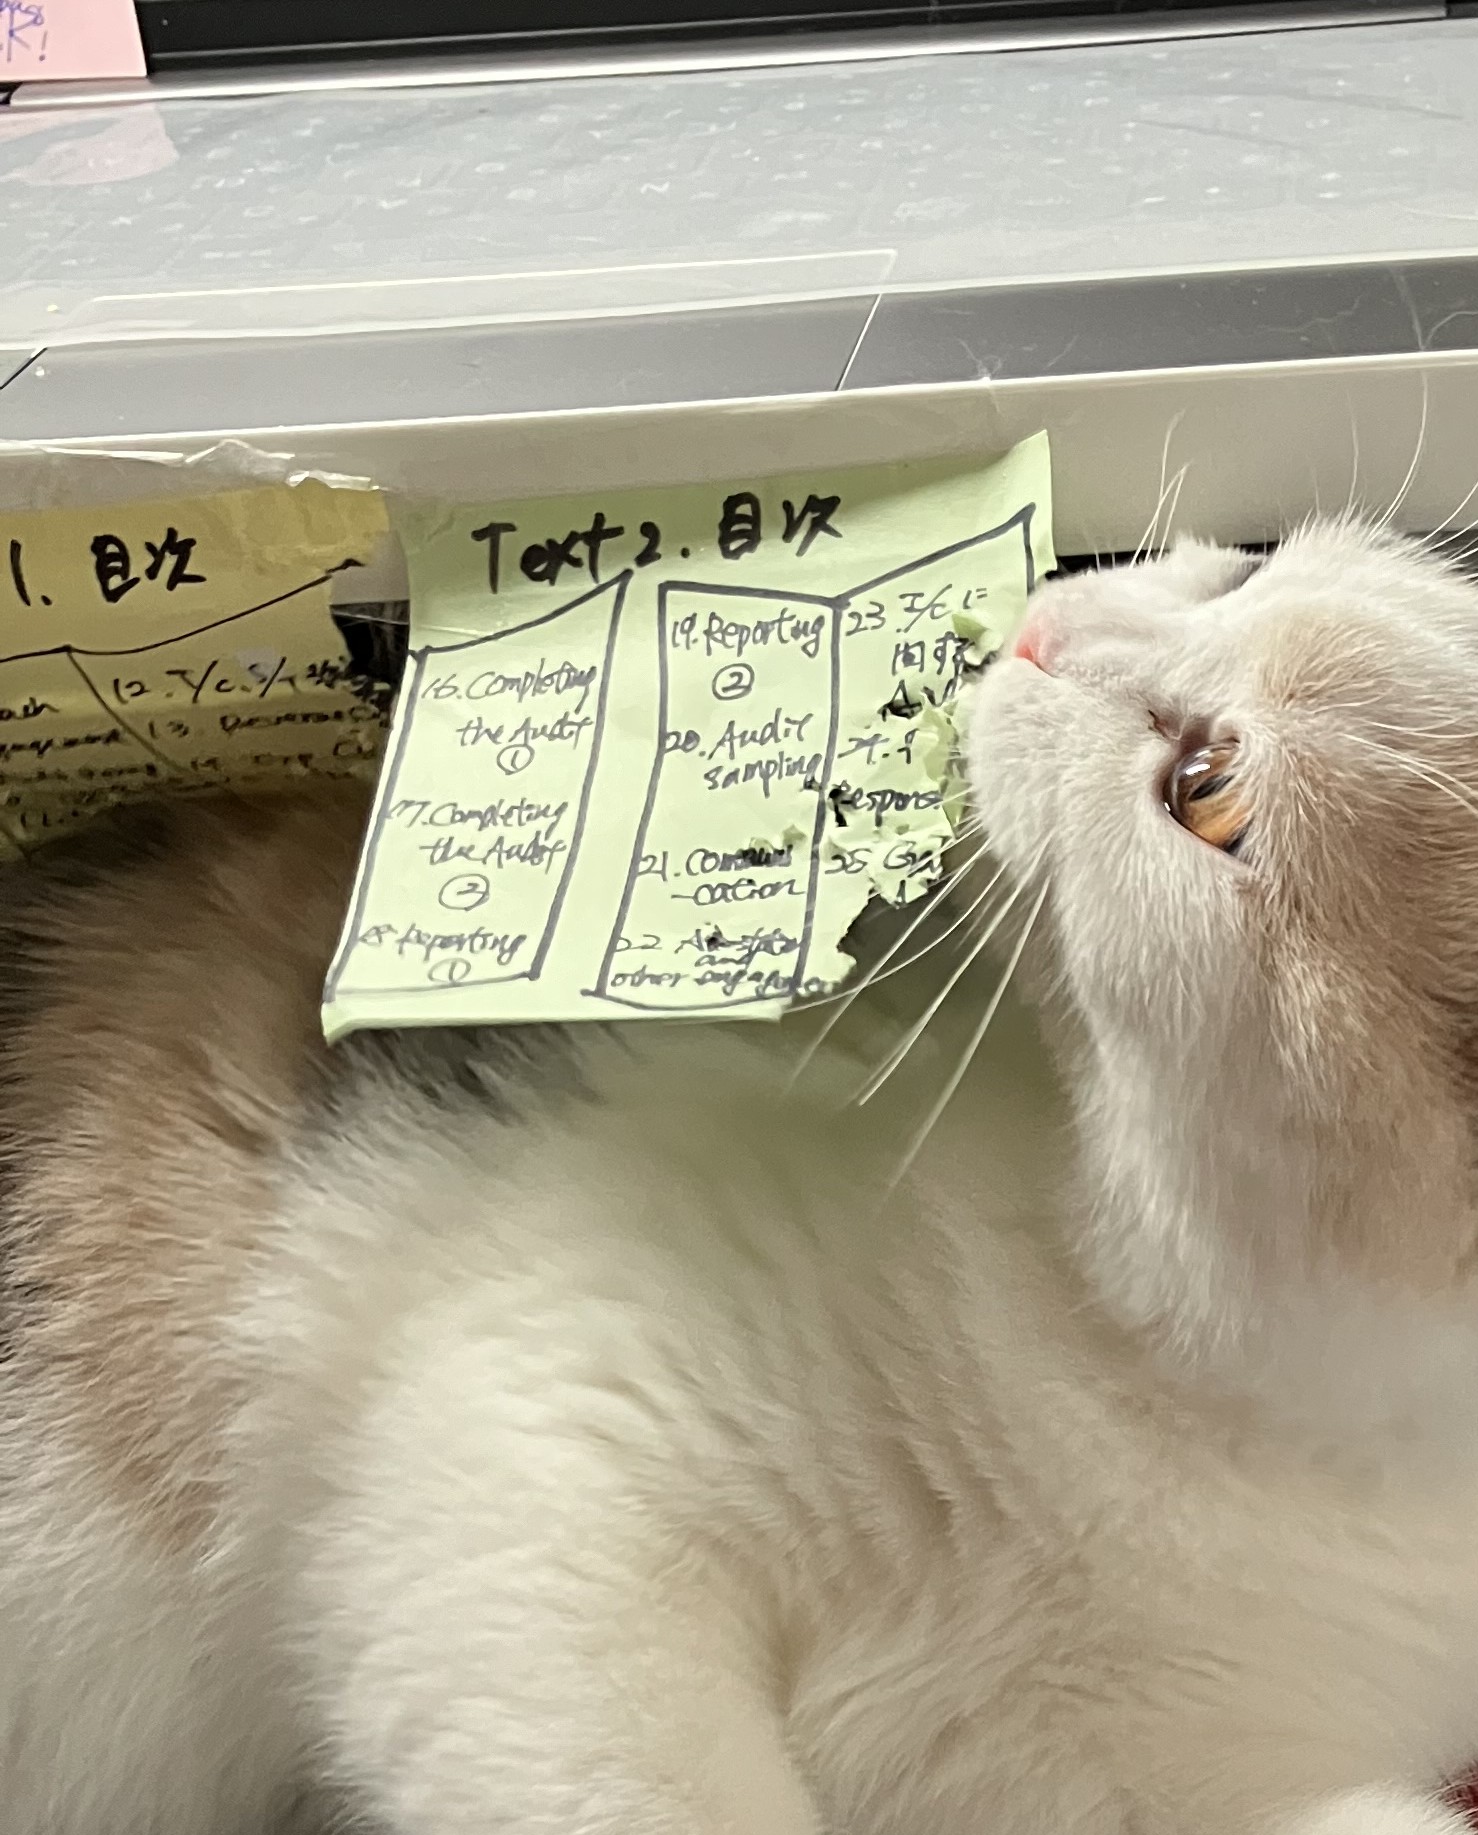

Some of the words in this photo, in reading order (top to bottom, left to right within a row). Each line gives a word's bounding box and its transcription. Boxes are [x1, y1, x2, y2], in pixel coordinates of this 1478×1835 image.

[90, 527, 207, 603] 目次
[471, 512, 624, 594] Text
[718, 491, 843, 560] 目次
